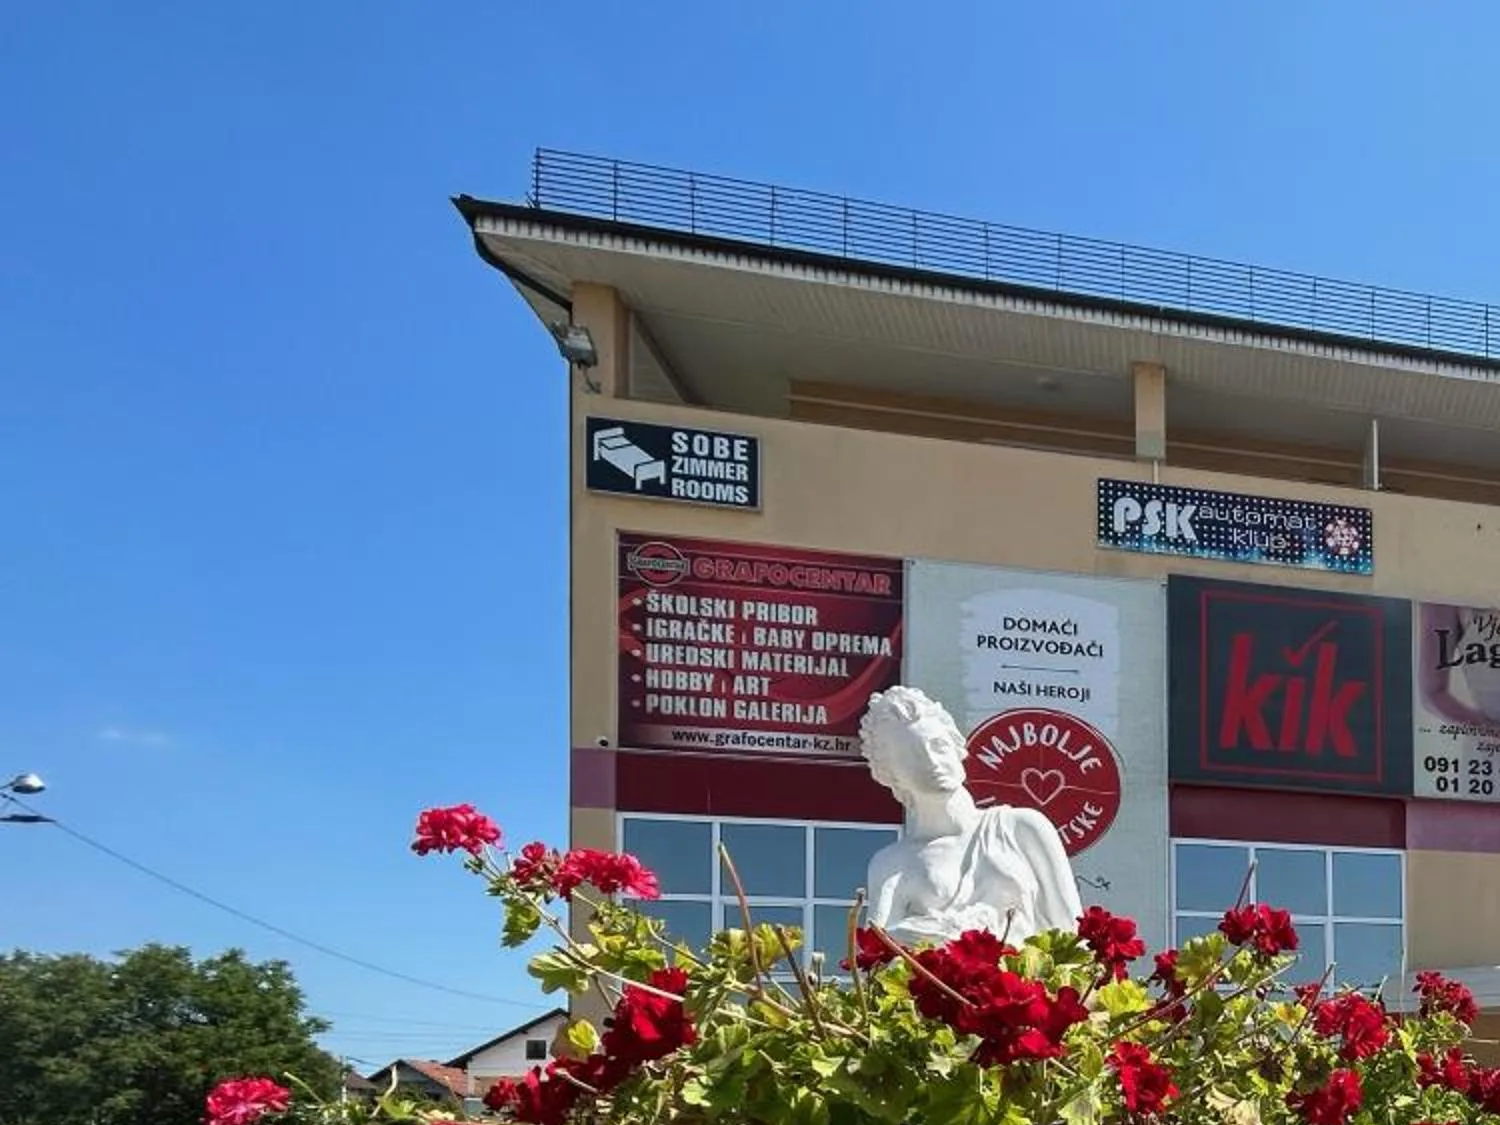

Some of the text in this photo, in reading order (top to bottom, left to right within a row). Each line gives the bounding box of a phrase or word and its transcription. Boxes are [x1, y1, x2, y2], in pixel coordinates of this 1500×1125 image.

[671, 431, 749, 461] SOBE
[671, 455, 749, 481] ZIMMER
[671, 477, 749, 503] ROOMS
[1113, 497, 1317, 541] PSK automat
[693, 557, 892, 595] GRAFOCENTAR
[646, 589, 818, 626] ŠKOLSKI PRIBOR
[646, 617, 735, 644] IGRAČKE
[753, 627, 805, 649] BABY
[811, 631, 892, 656] OPREMA
[1003, 616, 1079, 636] DOMAĆI
[646, 643, 849, 677] UREDSKI MATERIJAL
[976, 634, 1104, 658] PROIZVOĐAČI
[646, 668, 715, 693] HOBBY
[733, 675, 771, 696] ART
[993, 681, 1091, 702] NAŠI HEROJI
[646, 693, 828, 724] POKLON GALERIJA
[671, 731, 851, 747] www.grafocentar-kz.hr
[976, 721, 1104, 775] NAJBOLJE
[1423, 755, 1460, 773] 091
[1467, 759, 1493, 775] 23
[1436, 776, 1460, 793] 01
[1468, 778, 1494, 795] 20
